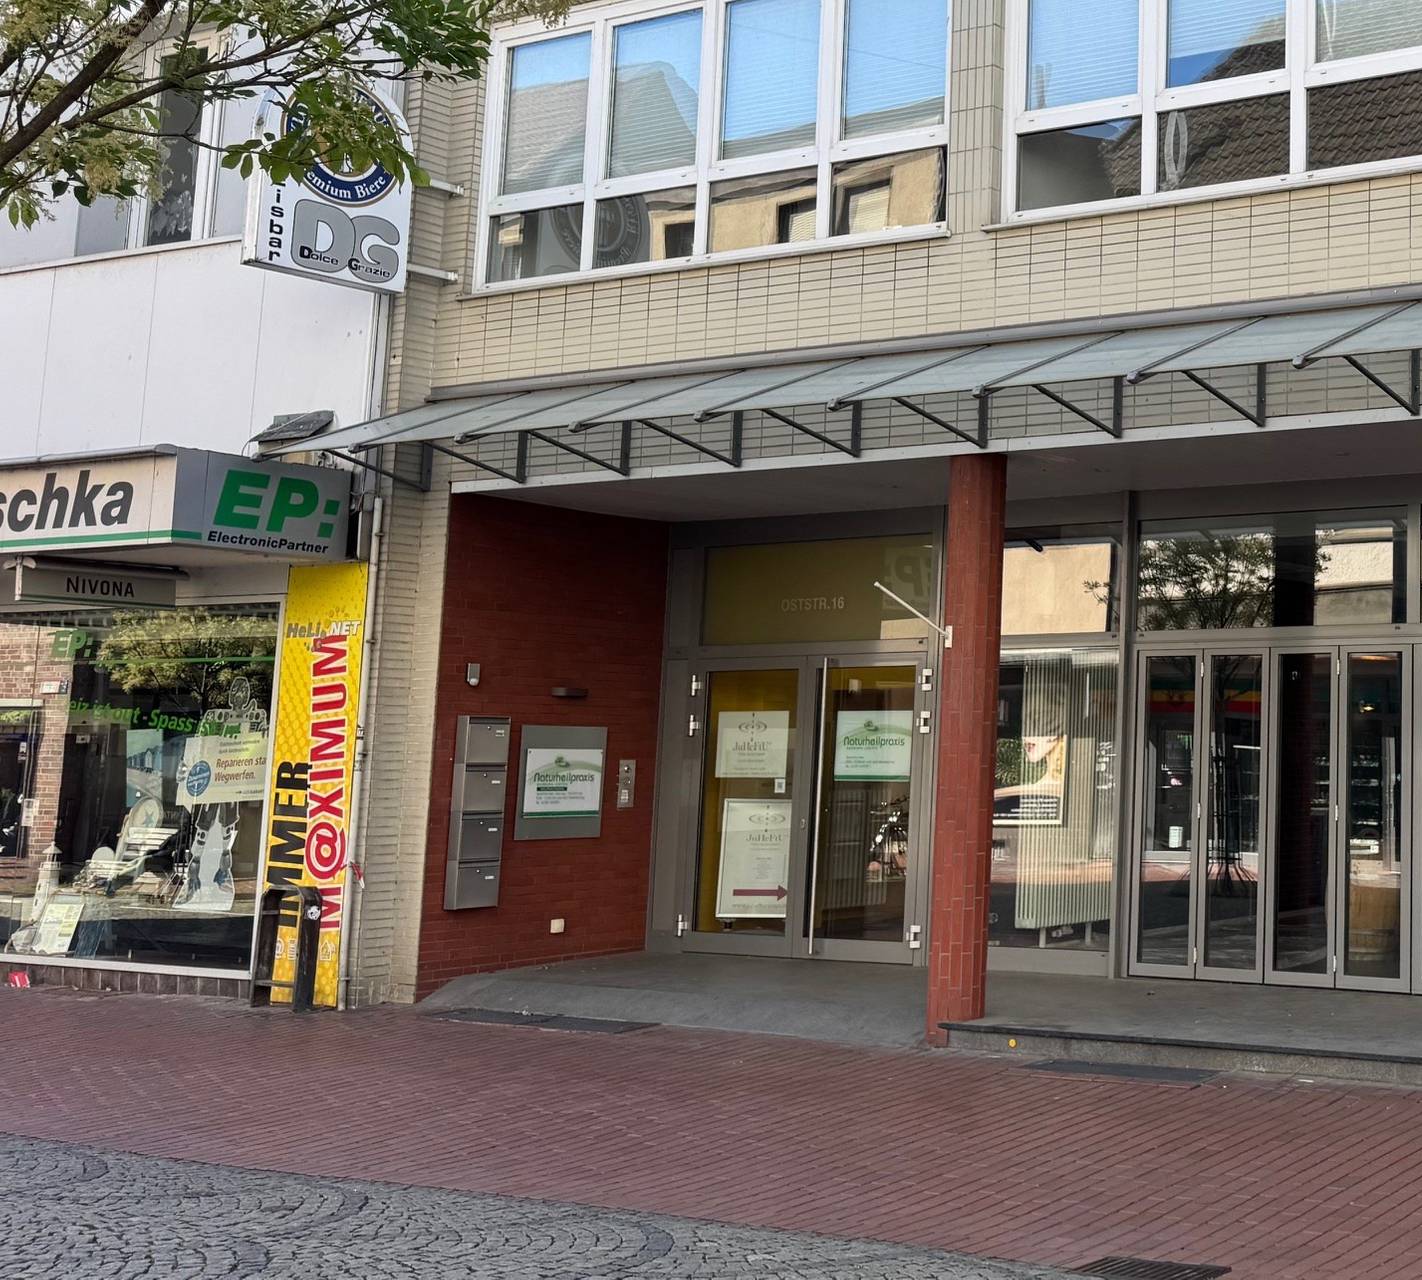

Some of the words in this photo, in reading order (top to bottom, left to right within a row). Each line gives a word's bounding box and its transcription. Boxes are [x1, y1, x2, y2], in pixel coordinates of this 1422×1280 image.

[306, 170, 352, 199] emium
[354, 176, 386, 199] Biere
[268, 182, 286, 262] isbar
[299, 245, 339, 266] Dolce
[347, 257, 391, 278] Grazie
[0, 469, 134, 532] chka
[213, 469, 340, 538] EP:
[207, 530, 329, 554] ElectronicPartner
[66, 575, 135, 598] NIVONA
[148, 709, 193, 732] Spass
[305, 634, 347, 930] M@XIMUM
[264, 761, 312, 928] IMMER
